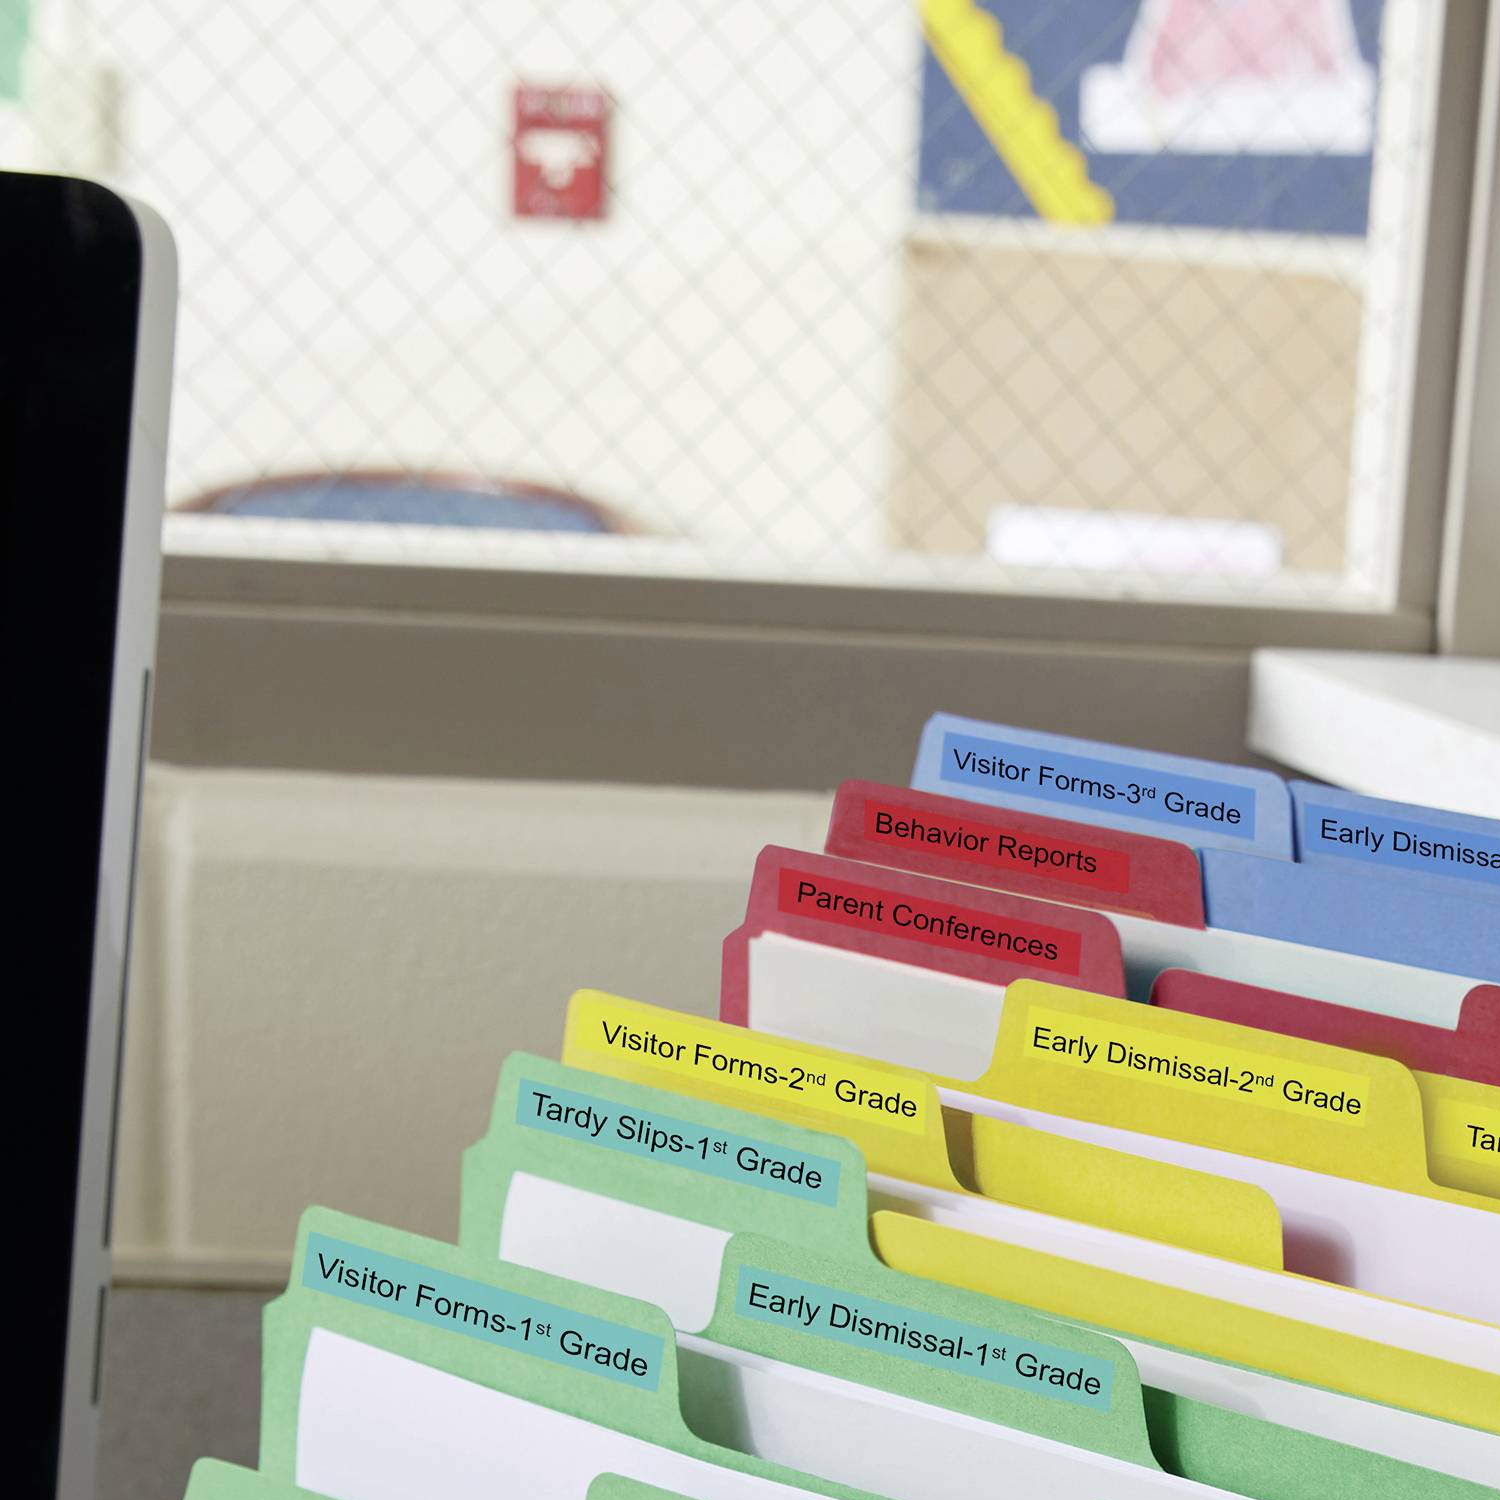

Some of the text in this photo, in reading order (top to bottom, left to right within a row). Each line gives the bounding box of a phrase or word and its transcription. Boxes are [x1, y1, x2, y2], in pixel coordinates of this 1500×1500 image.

[953, 748, 1031, 783] Visitor
[1164, 791, 1241, 824] Grade
[875, 811, 1097, 873] Behavior Reports
[1321, 818, 1385, 853] Early
[797, 881, 1058, 961] Parent Conferences
[602, 1020, 687, 1061] Visitor
[835, 1079, 917, 1118] Grade
[1033, 1026, 1099, 1064] Early
[1282, 1079, 1361, 1115] Grade
[532, 1091, 609, 1138] Tardy
[736, 1146, 822, 1189] Grade
[318, 1252, 408, 1302] Visitor
[559, 1330, 648, 1377] Grade
[748, 1282, 821, 1327] Early
[1015, 1353, 1101, 1396] Grade
